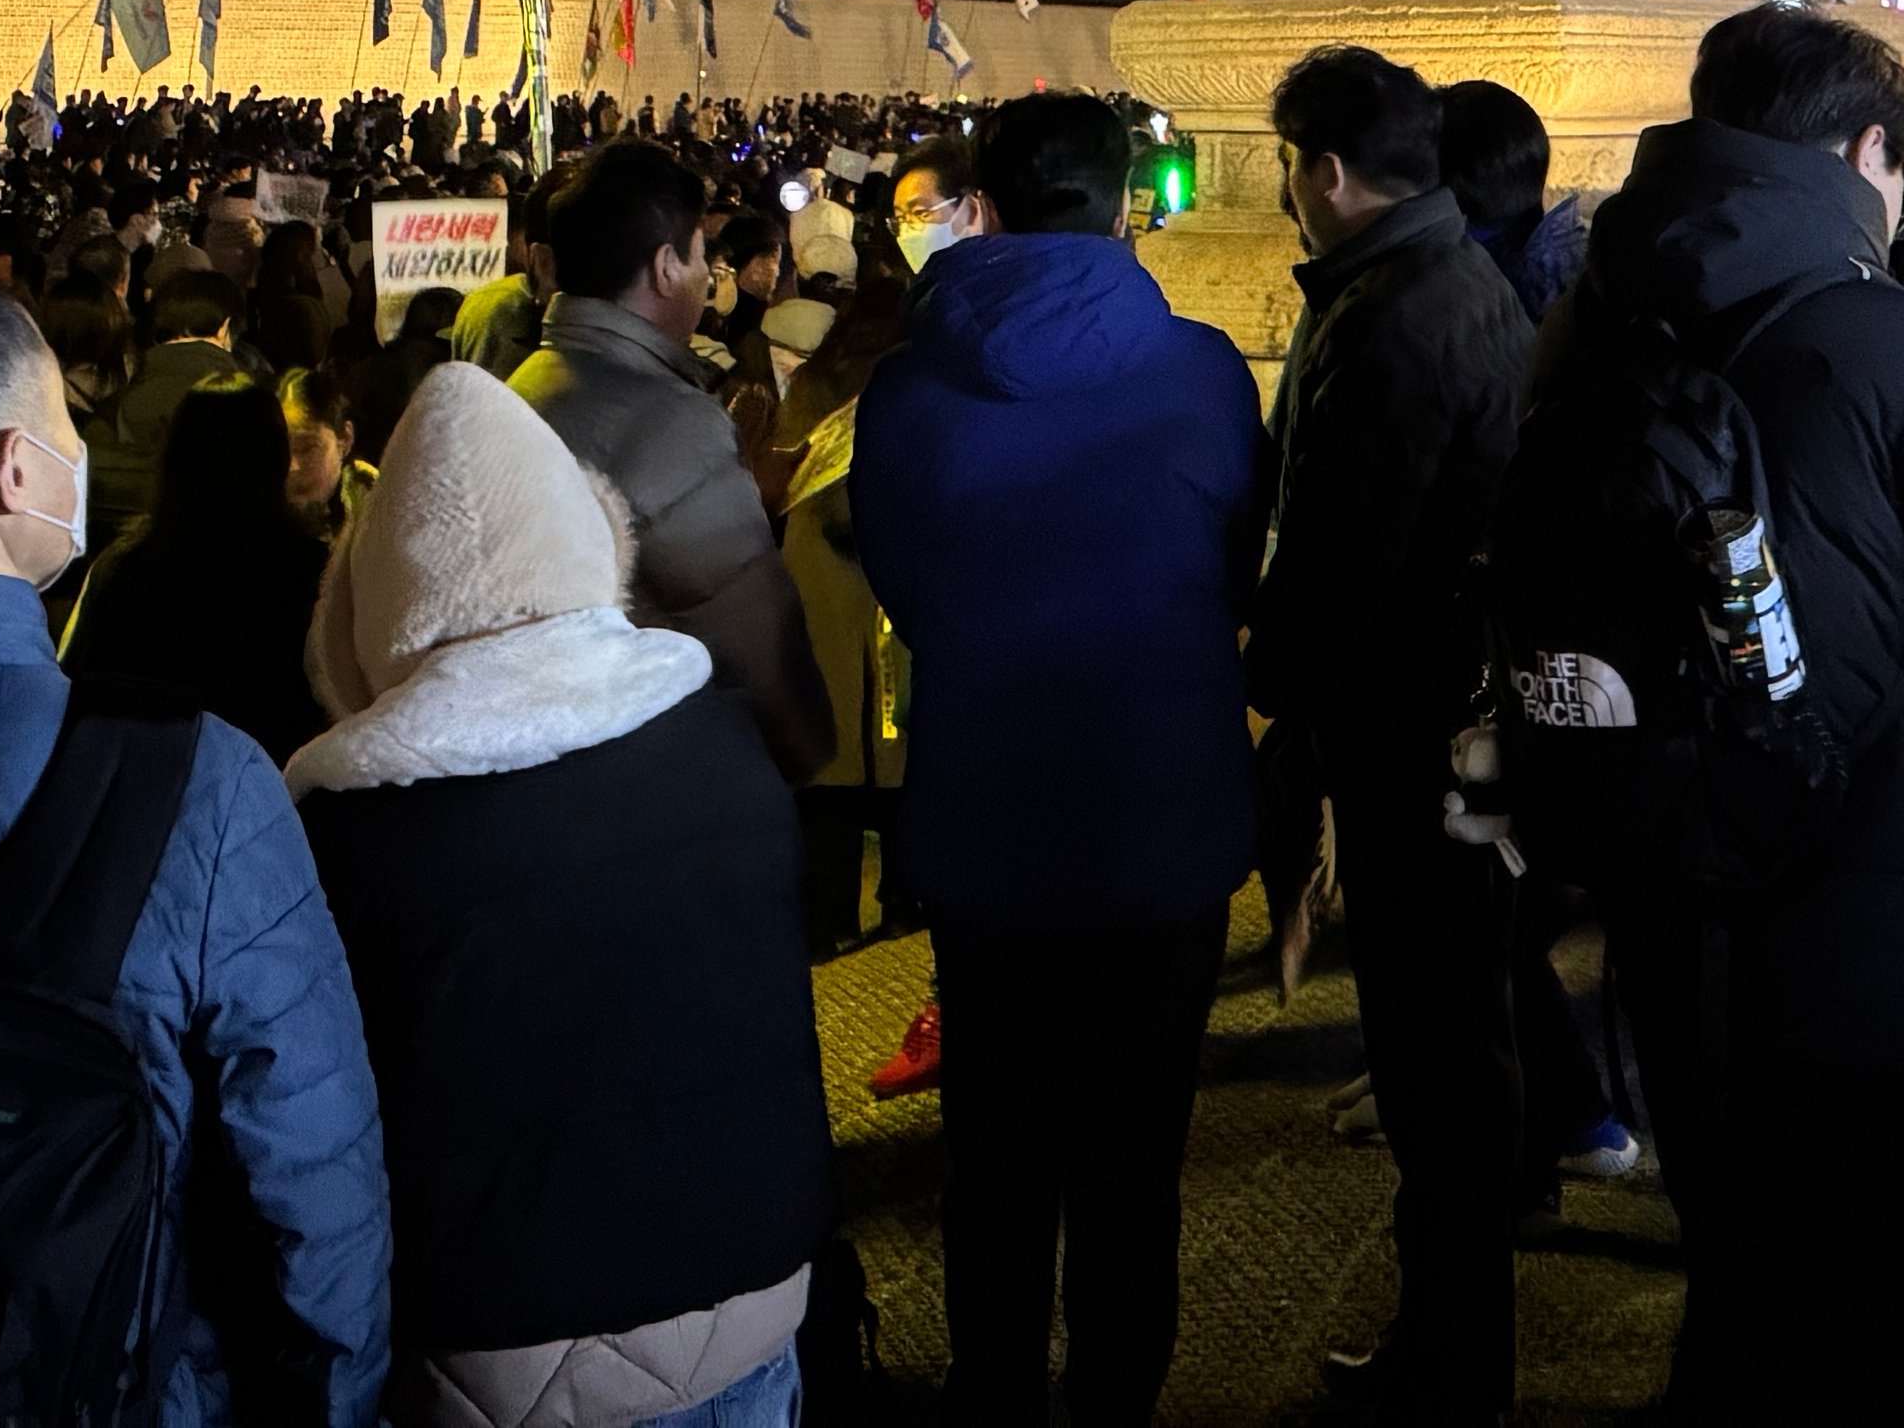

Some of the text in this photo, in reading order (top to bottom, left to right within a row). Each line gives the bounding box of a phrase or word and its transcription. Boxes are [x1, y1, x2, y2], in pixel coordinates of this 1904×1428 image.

[1536, 650, 1578, 677] THE
[1510, 666, 1581, 703] ORTH
[1523, 698, 1587, 727] FACE
